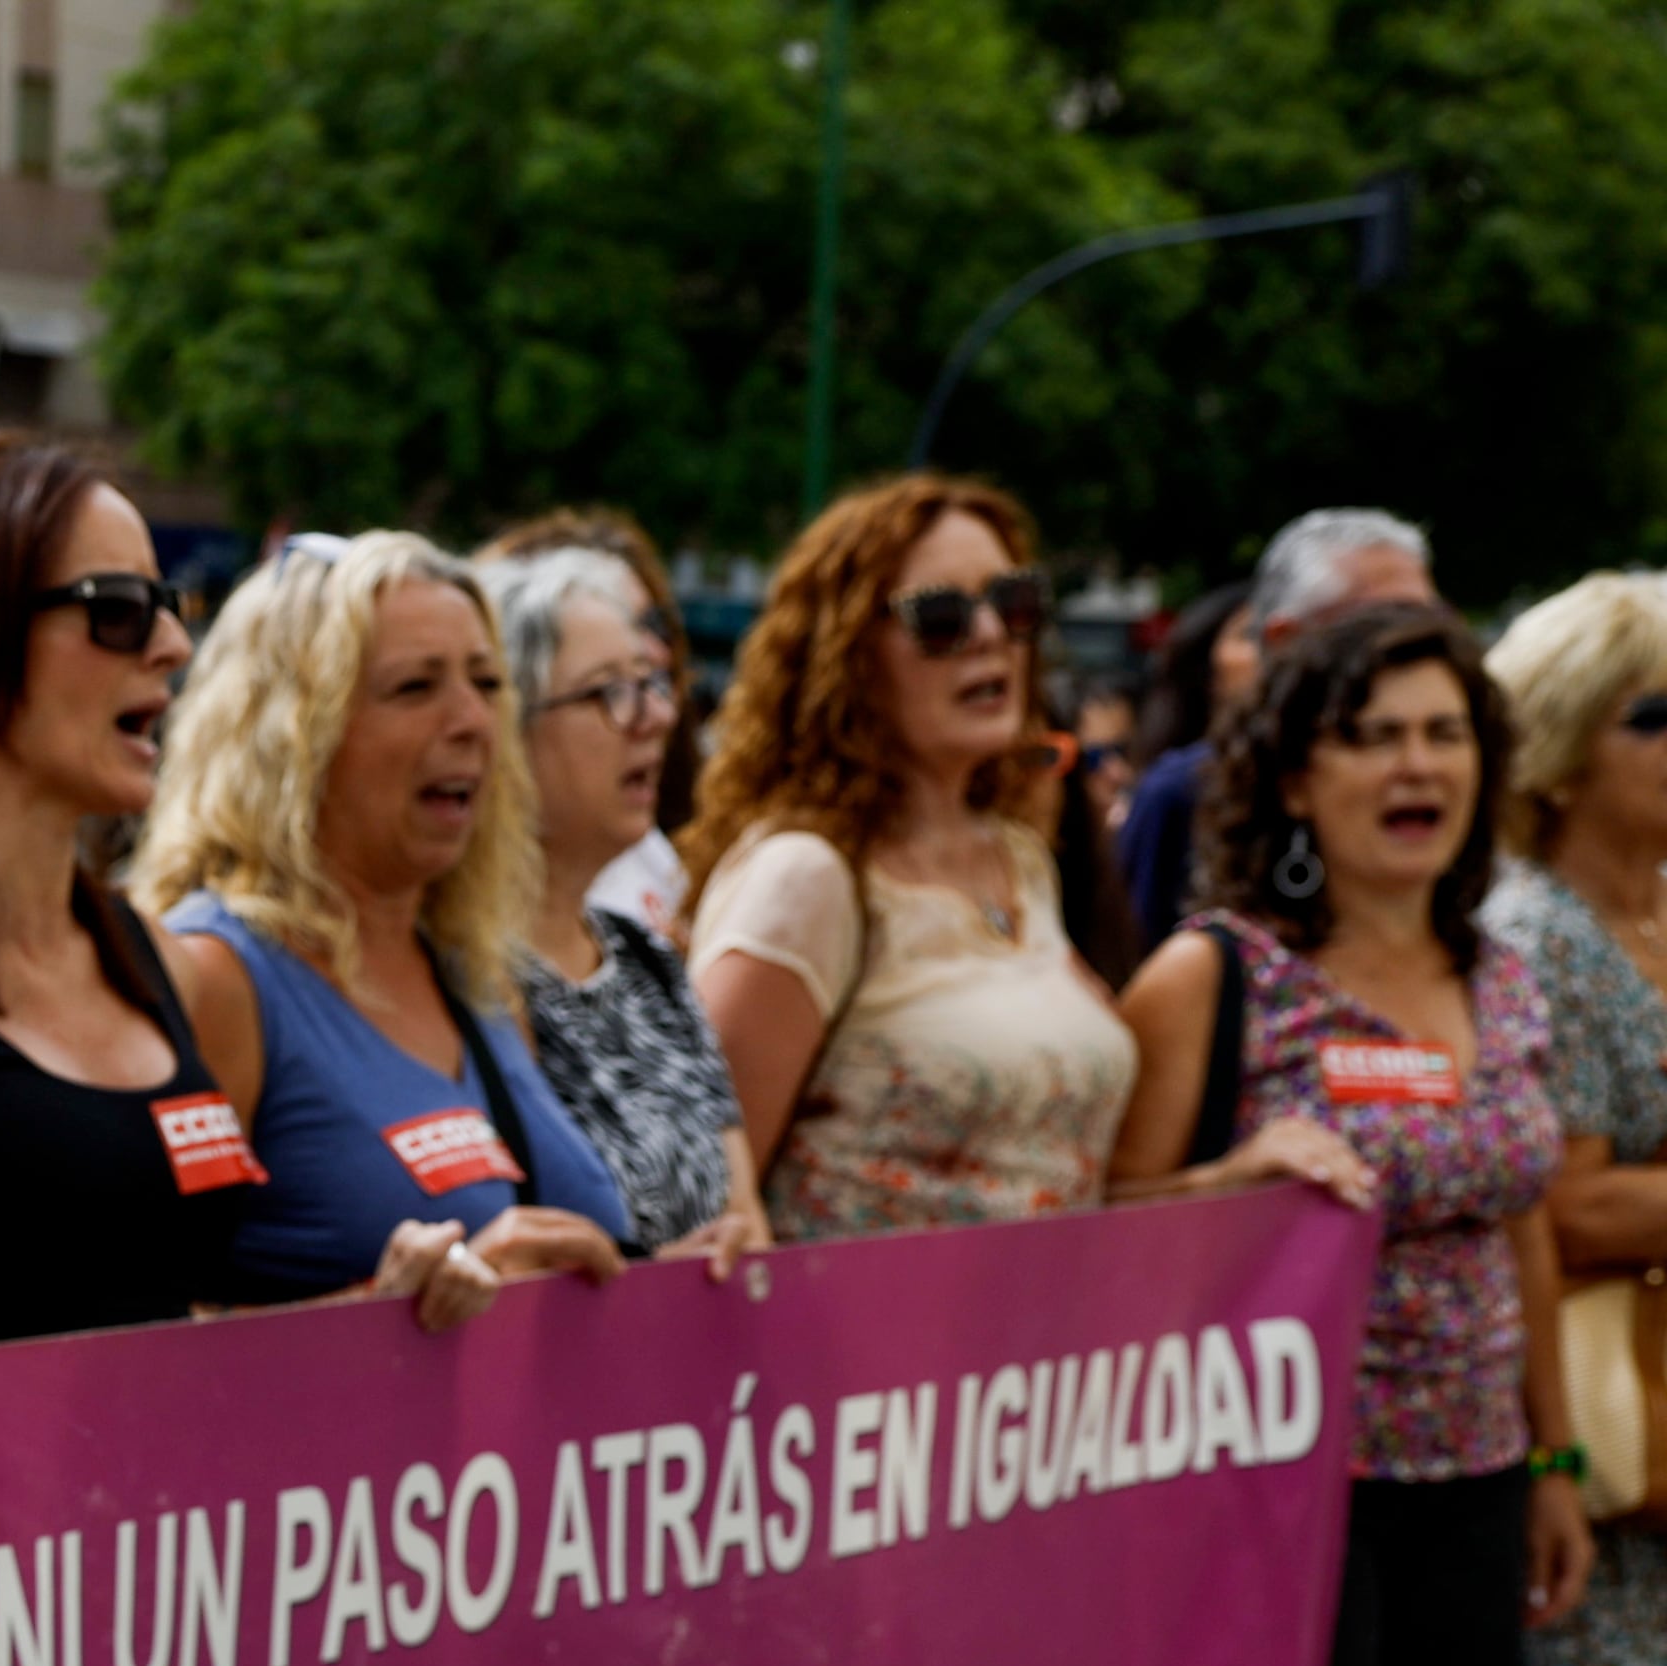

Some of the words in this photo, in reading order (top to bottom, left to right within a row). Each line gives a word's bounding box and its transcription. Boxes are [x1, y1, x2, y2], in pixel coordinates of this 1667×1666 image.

[531, 1371, 816, 1619] ATRÁS
[829, 1381, 938, 1558] EN
[948, 1315, 1325, 1531] IGUALDAD
